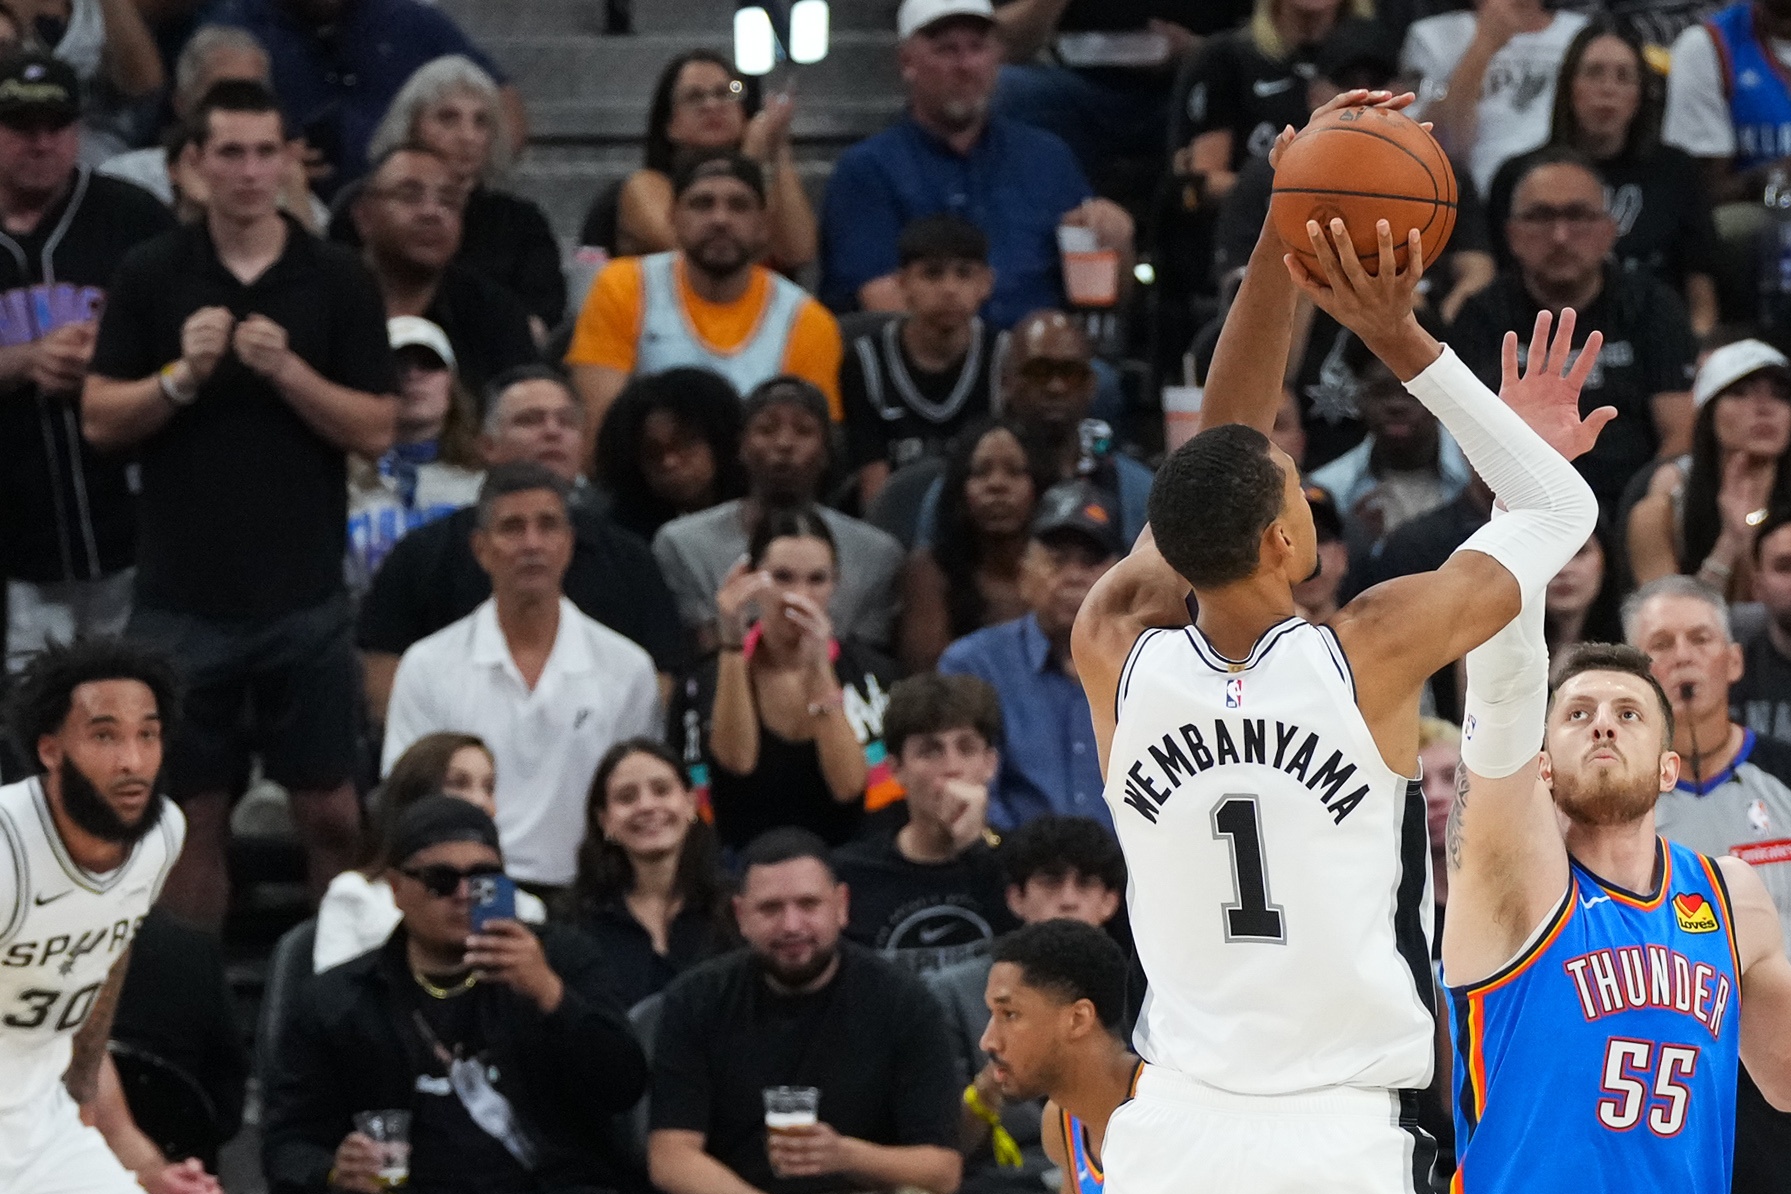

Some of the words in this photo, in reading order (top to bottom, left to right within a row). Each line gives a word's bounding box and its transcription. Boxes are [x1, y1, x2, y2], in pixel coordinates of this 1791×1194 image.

[1124, 718, 1370, 825] WEMBANYAMA
[1209, 793, 1287, 945] 1
[3, 981, 102, 1031] 30
[1564, 945, 1731, 1040] THUNDER
[1597, 1036, 1701, 1138] 55
